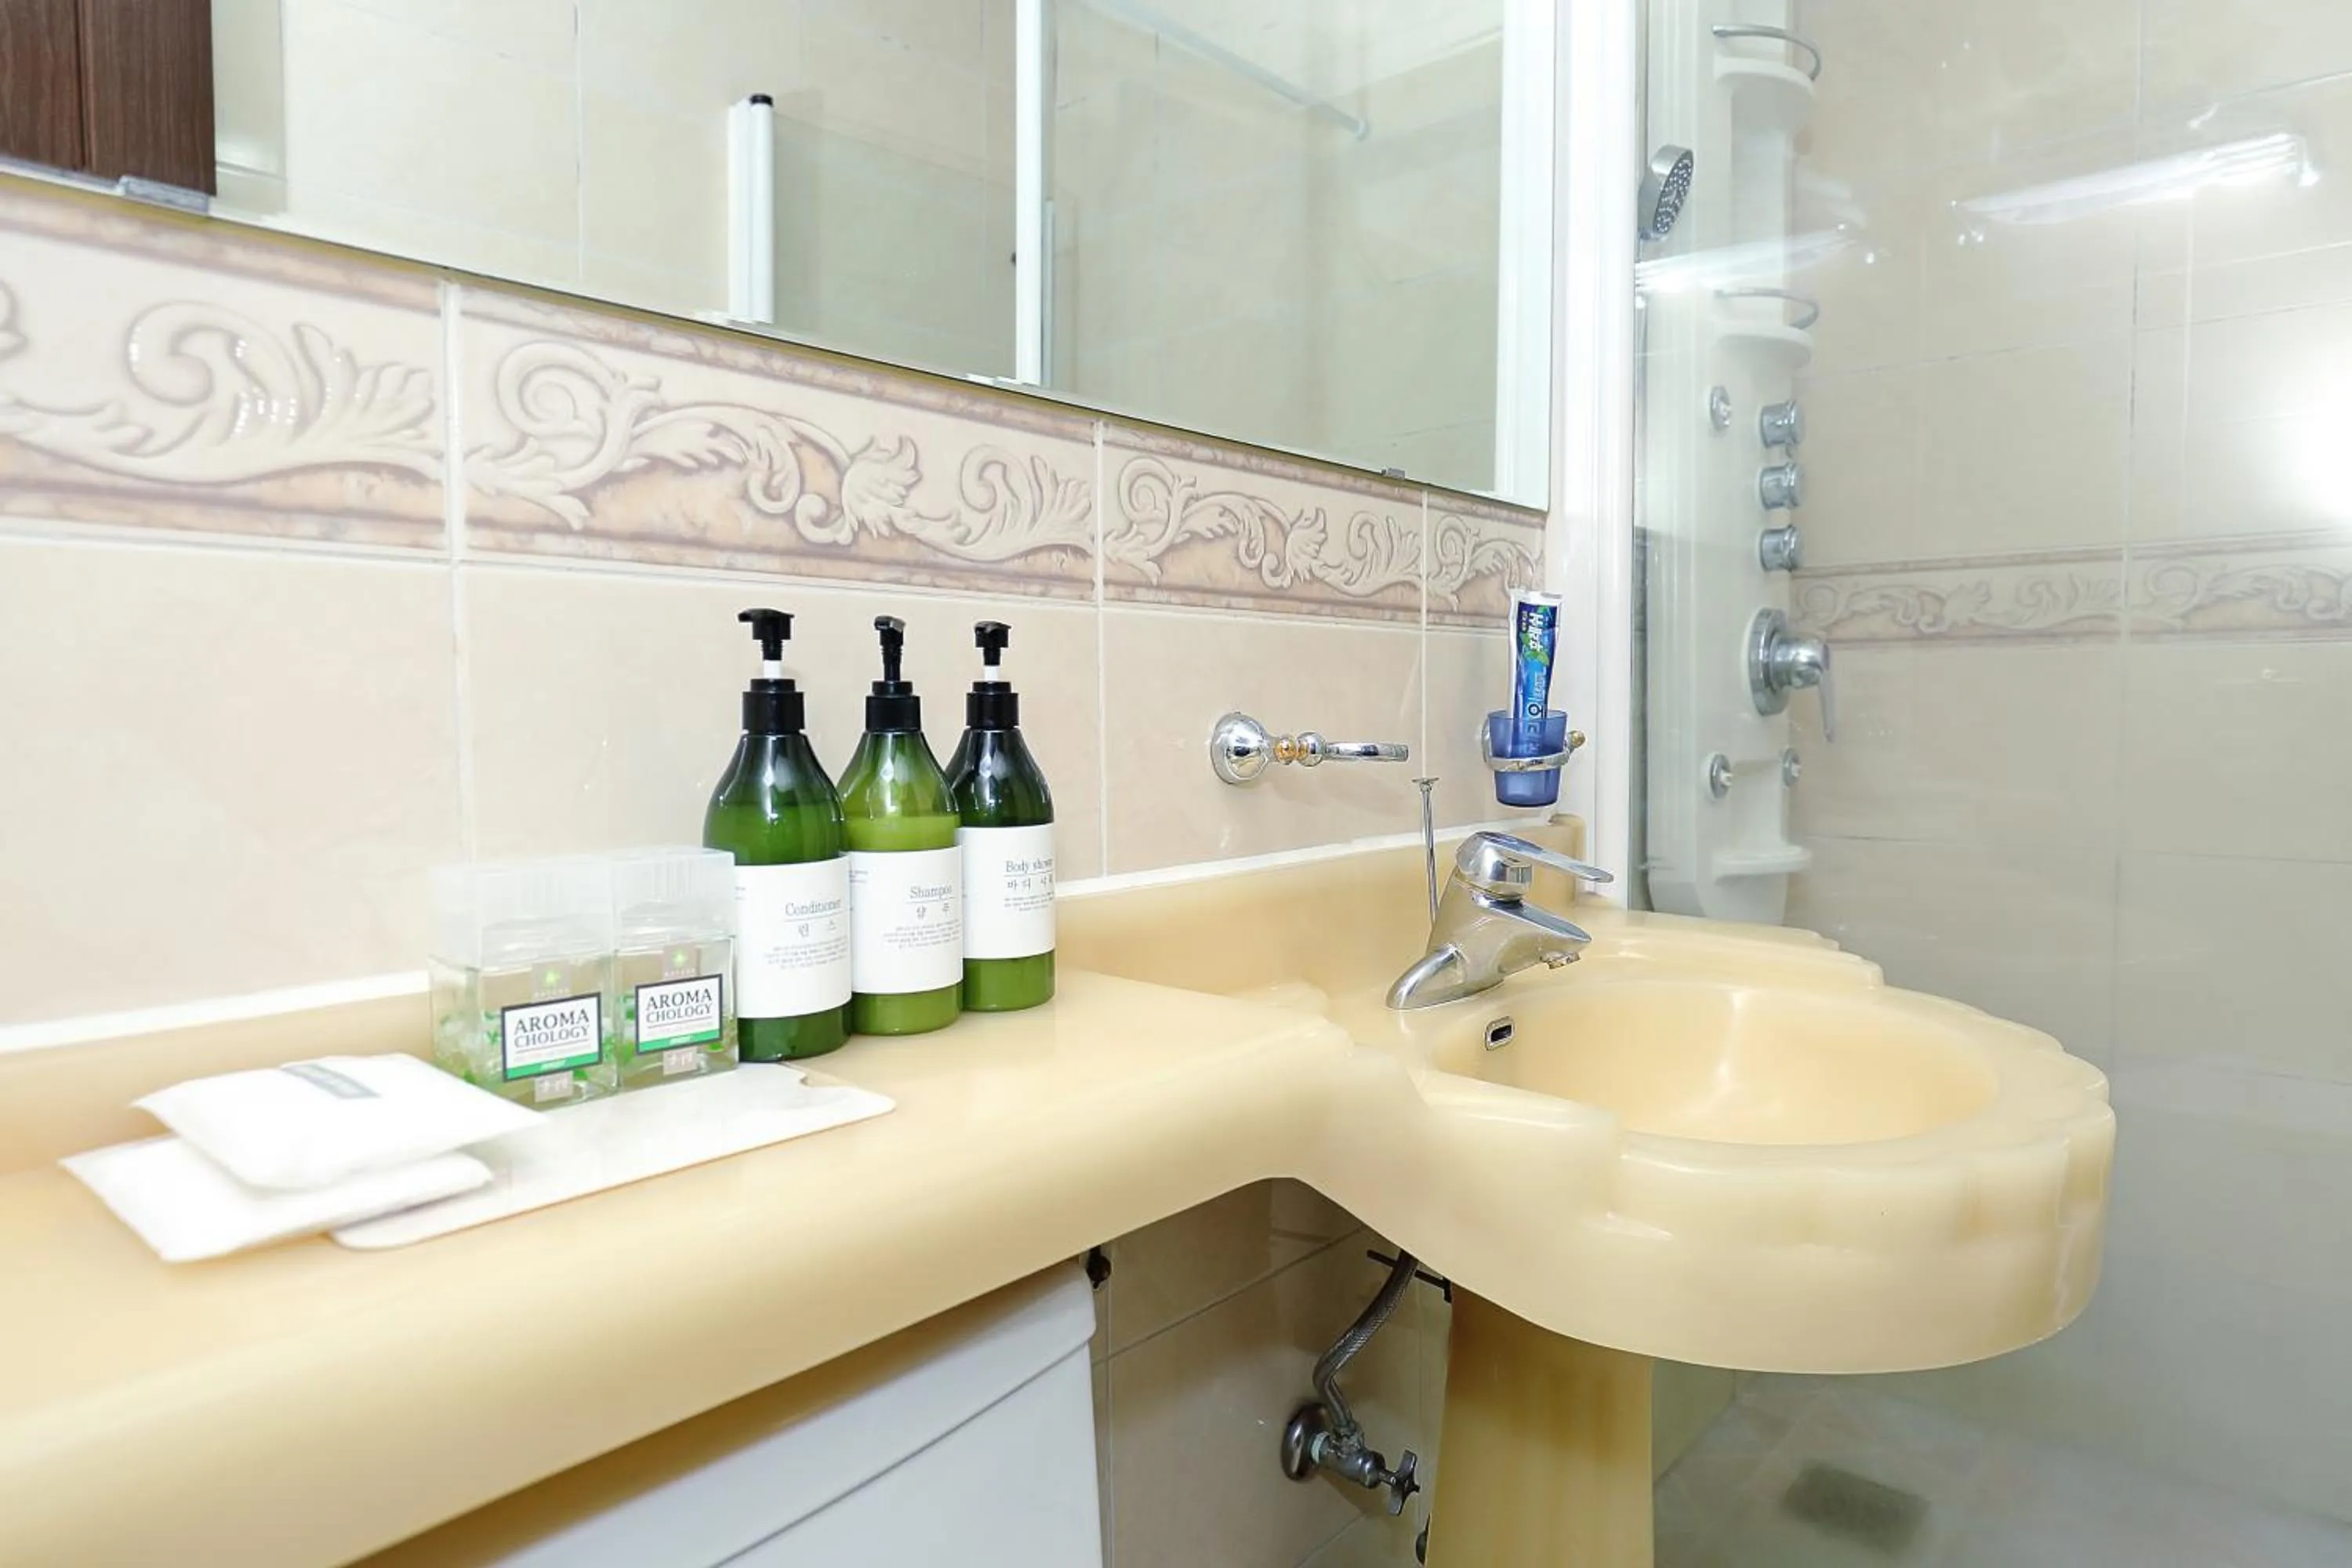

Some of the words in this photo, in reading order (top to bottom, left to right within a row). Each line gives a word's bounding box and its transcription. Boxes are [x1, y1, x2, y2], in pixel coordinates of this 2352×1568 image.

[1006, 859, 1029, 875] Body
[909, 884, 953, 900] Shampoo
[646, 989, 713, 1011] AROMA
[514, 1008, 590, 1036] AROMA
[646, 1003, 713, 1024] CHOLOGY
[514, 1025, 590, 1048] CHOLOGY
